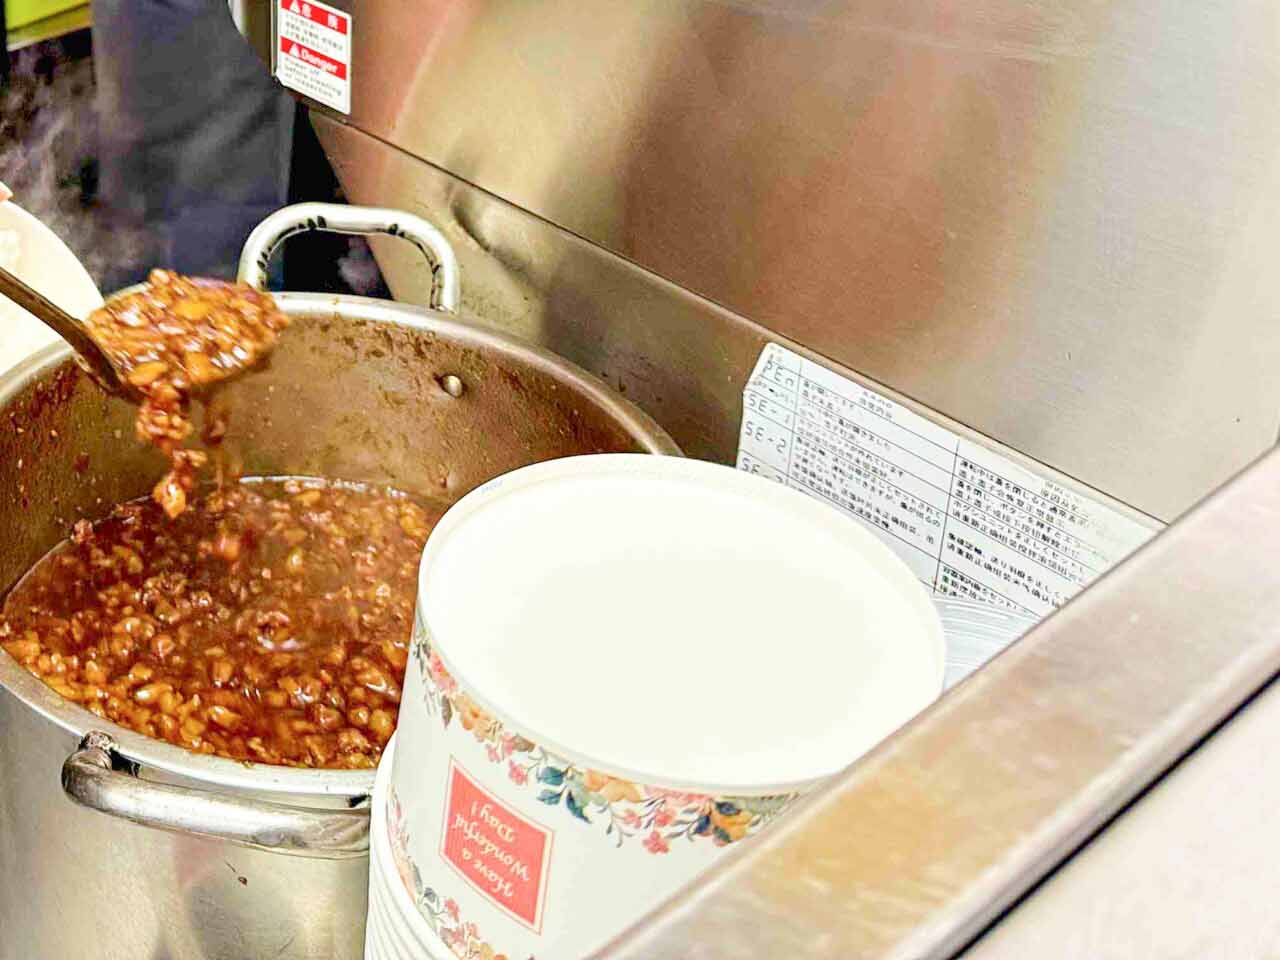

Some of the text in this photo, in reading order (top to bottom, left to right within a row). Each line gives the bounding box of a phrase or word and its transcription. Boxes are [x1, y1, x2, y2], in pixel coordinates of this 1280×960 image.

[301, 49, 338, 73] Danger
[451, 812, 531, 882] Wonderful
[461, 847, 514, 898] Have a
